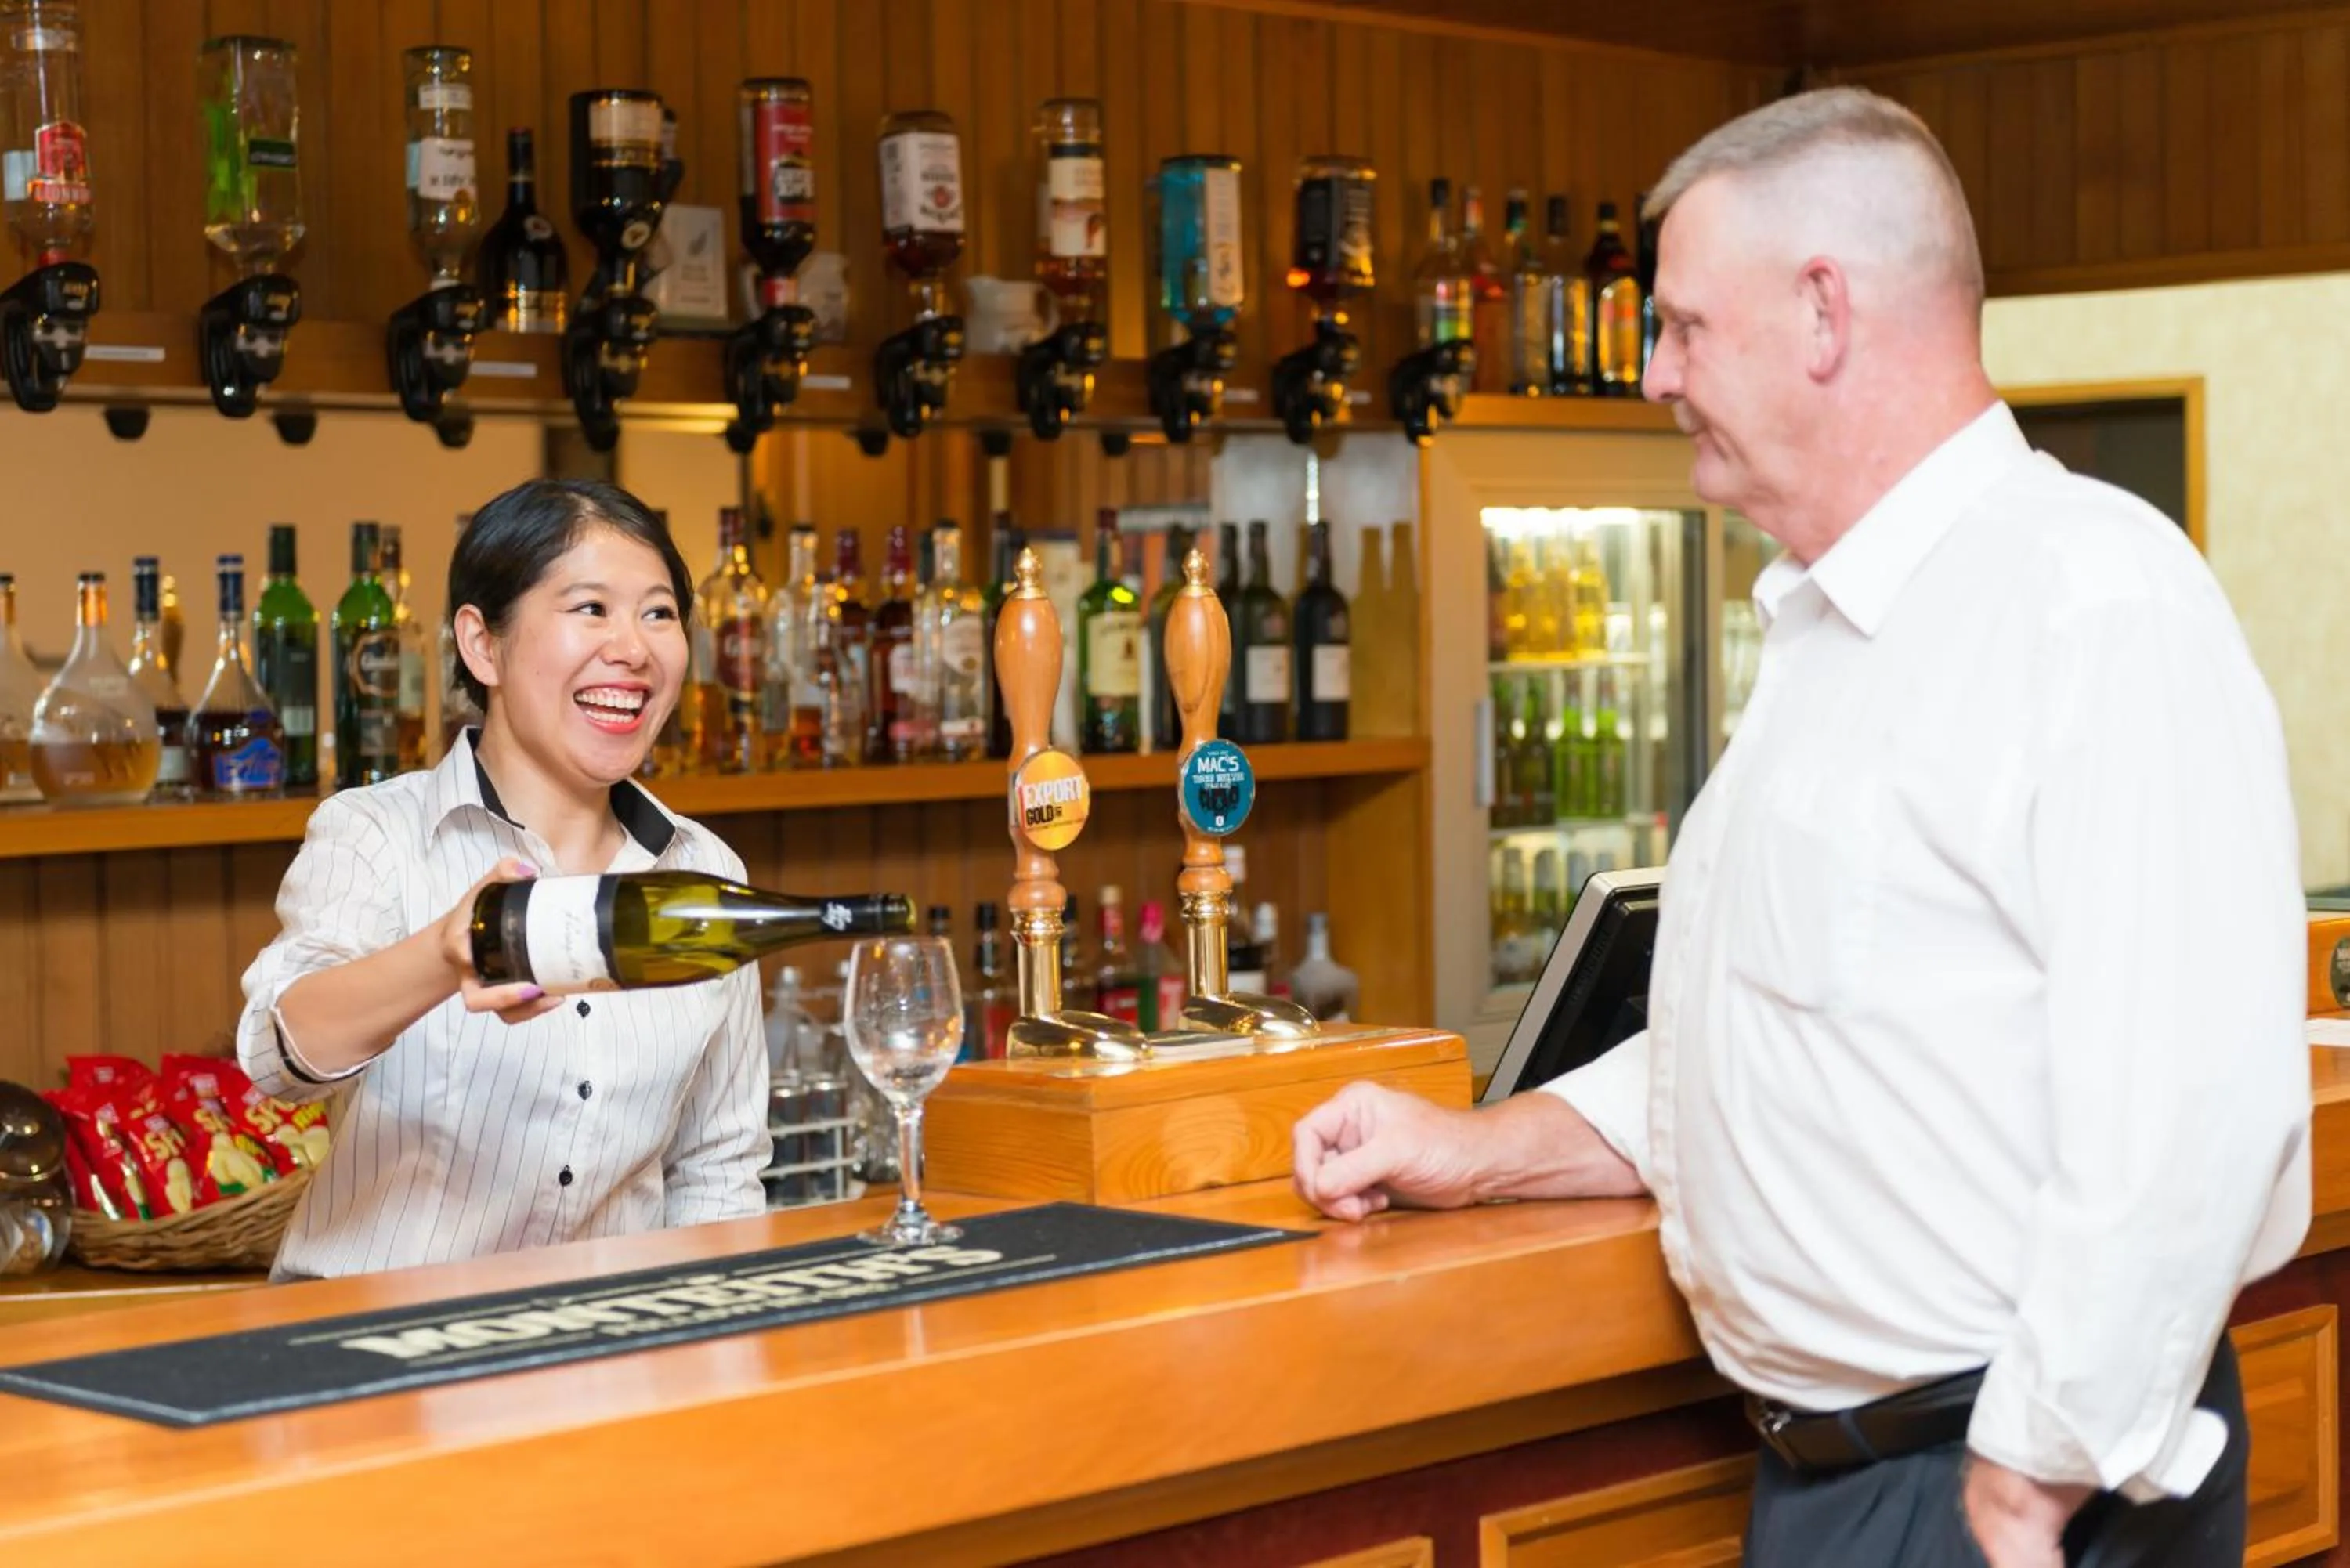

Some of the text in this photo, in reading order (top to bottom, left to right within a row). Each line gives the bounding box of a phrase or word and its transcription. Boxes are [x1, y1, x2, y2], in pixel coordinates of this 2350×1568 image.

[1197, 755, 1240, 773] MAC'S
[1022, 775, 1083, 807] EXPORT
[1025, 804, 1054, 826] GOLD
